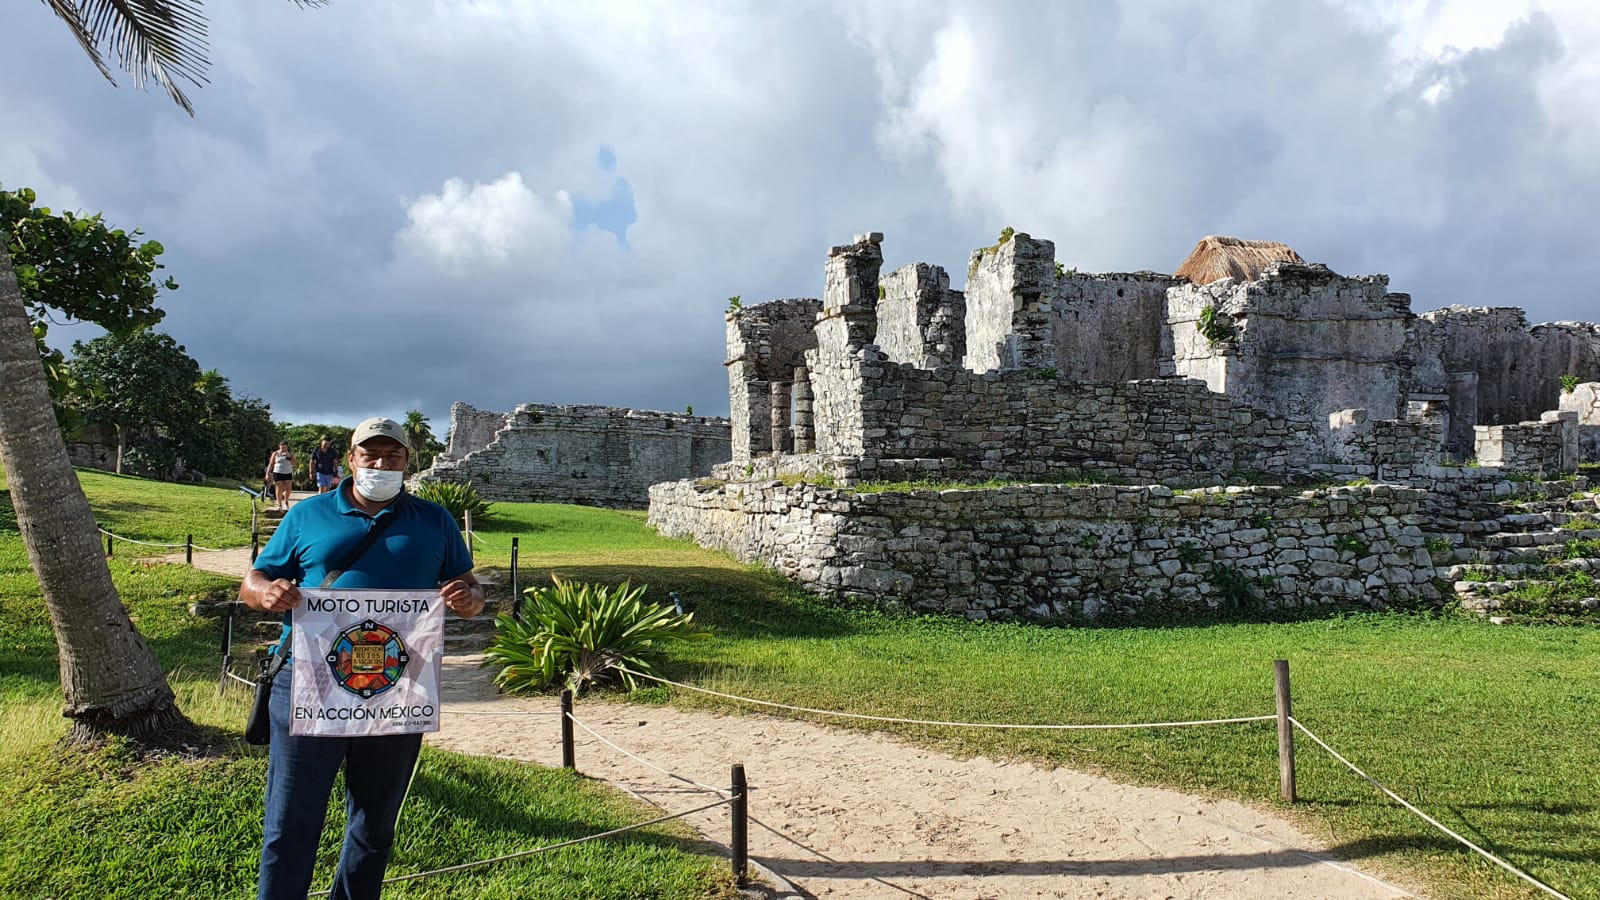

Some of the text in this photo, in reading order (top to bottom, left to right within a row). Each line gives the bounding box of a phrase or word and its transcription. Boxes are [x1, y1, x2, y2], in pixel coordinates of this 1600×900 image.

[307, 599, 430, 613] MOTO TURISTA
[295, 704, 434, 720] EN ACCIÓN MÉXICO
